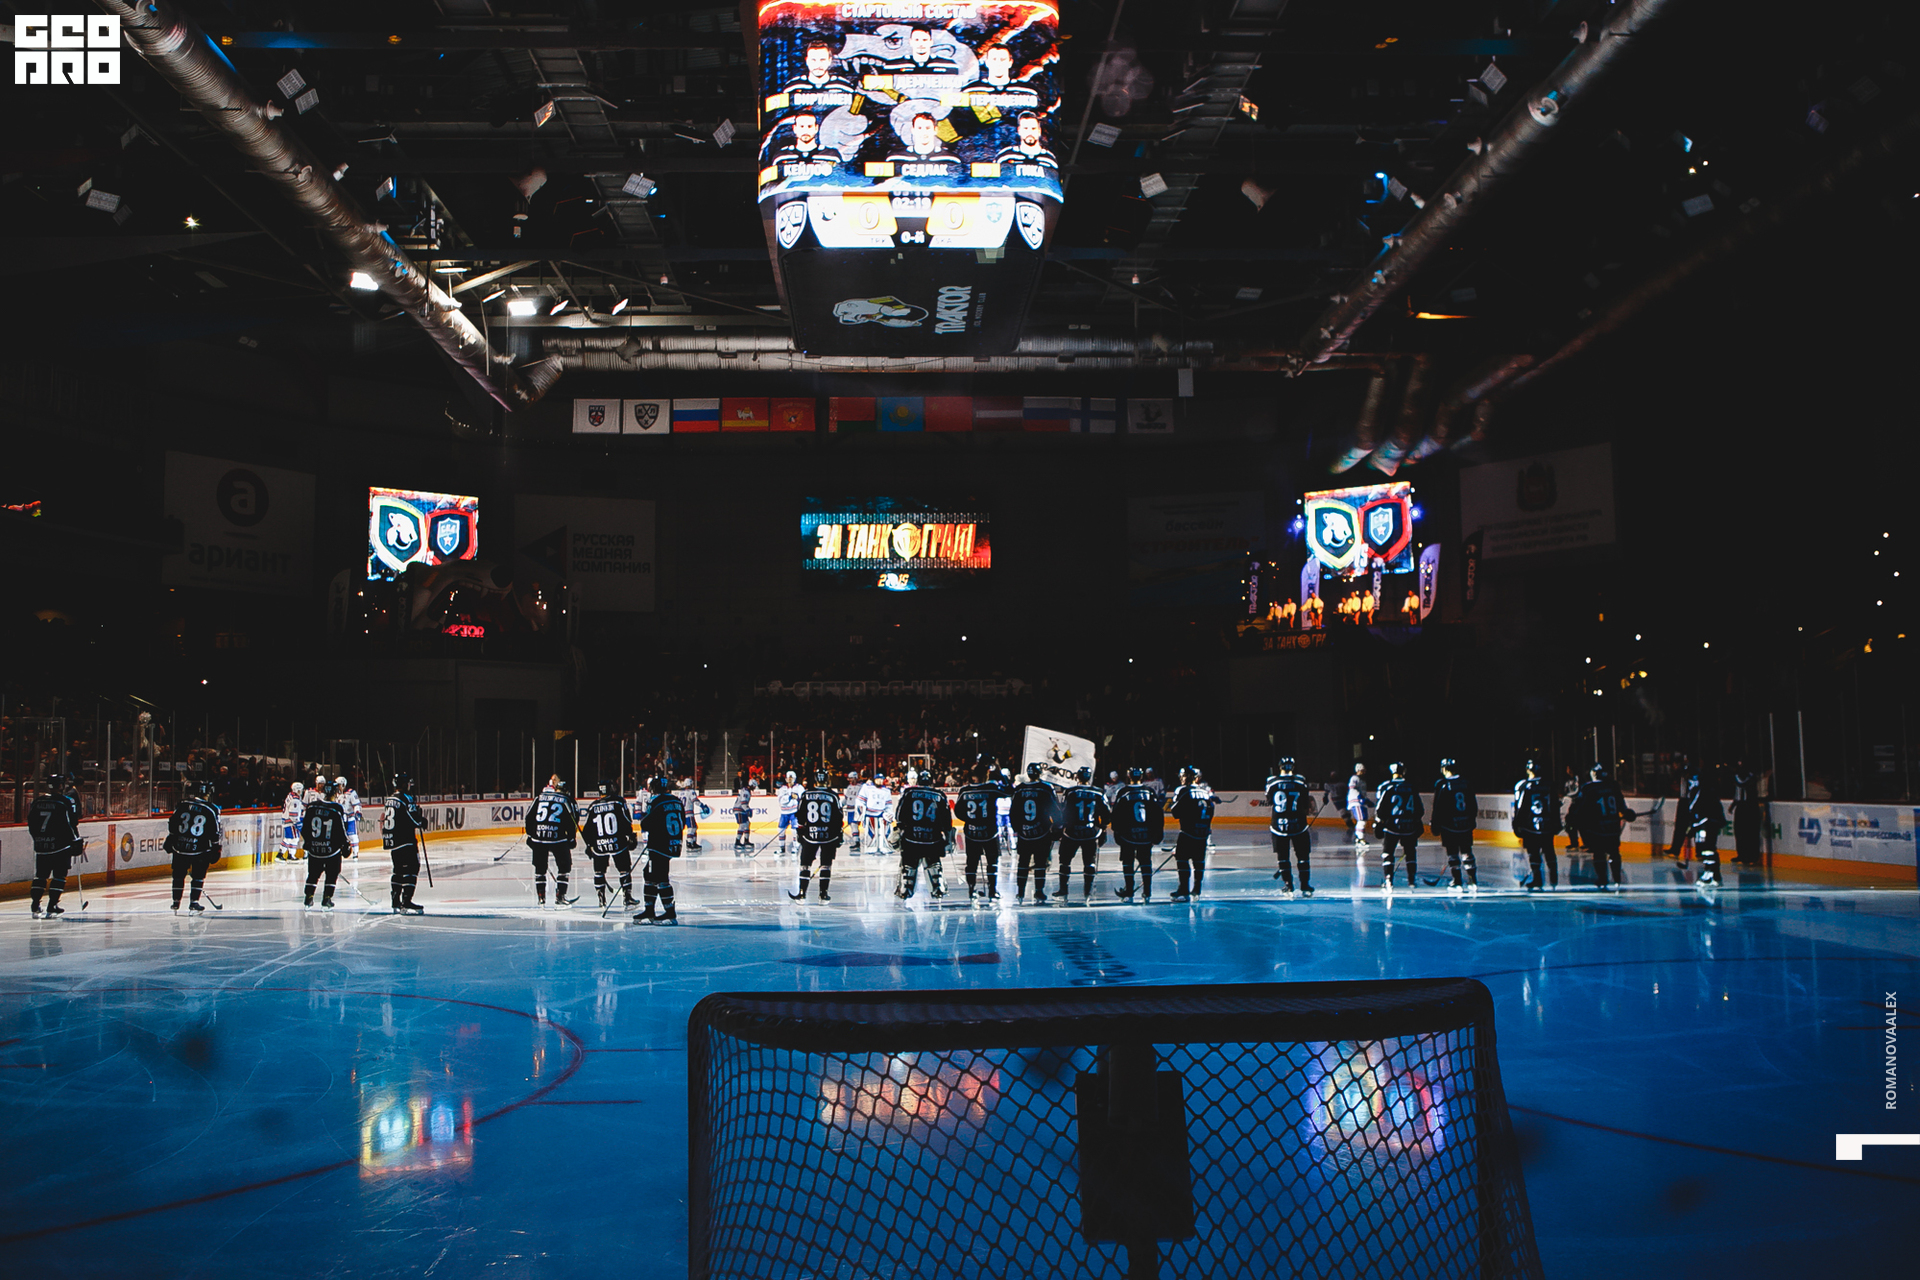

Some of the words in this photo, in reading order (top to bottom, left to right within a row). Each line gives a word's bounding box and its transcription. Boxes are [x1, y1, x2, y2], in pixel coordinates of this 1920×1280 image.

[925, 4, 977, 19] СОСТАВ
[901, 164, 948, 176] СЕДЛАК
[859, 201, 880, 230] 0
[943, 201, 964, 230] 0
[935, 285, 972, 335] TRAKTOR
[572, 533, 635, 546] РУССКАЯ
[814, 523, 843, 559] ЗА
[188, 542, 292, 576] ариант
[572, 546, 632, 560] МЕДНАЯ
[572, 560, 651, 574] КОМПАНИЯ
[535, 801, 564, 823] 52
[806, 800, 832, 823] 89
[911, 799, 938, 823] 94
[966, 799, 989, 819] 21
[1023, 799, 1037, 822] 9
[1133, 801, 1147, 823] 6
[1273, 790, 1301, 814] 97
[1390, 794, 1415, 816] 24
[1454, 792, 1466, 812] 8
[1596, 795, 1617, 816] 19
[39, 811, 52, 833] 7
[178, 812, 206, 837] 38
[311, 816, 333, 840] 91
[536, 824, 558, 832] КОНАР
[592, 812, 618, 837] 10
[225, 829, 249, 845] ЧТПЗ
[596, 837, 618, 846] КОНАР
